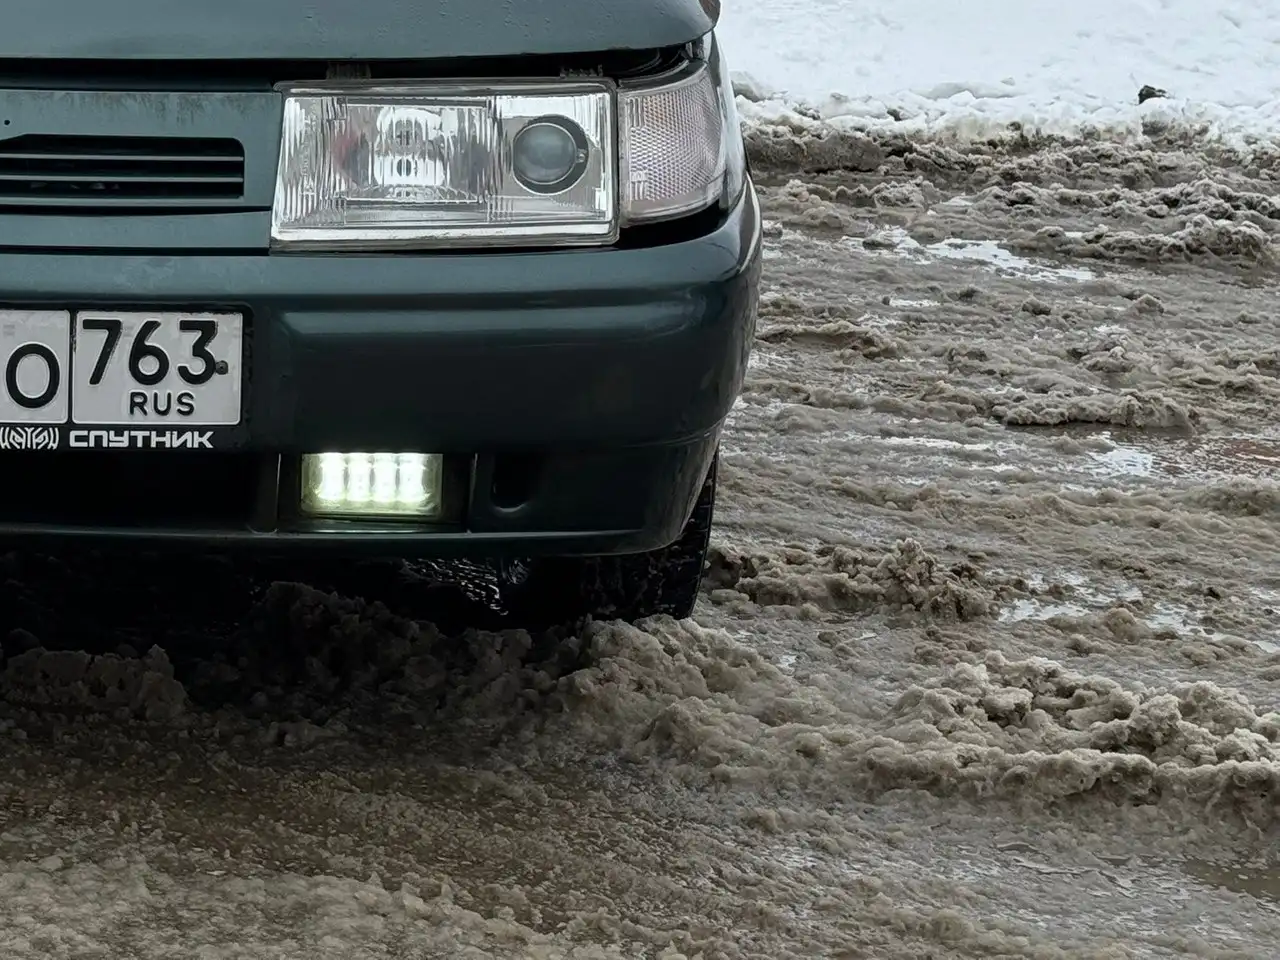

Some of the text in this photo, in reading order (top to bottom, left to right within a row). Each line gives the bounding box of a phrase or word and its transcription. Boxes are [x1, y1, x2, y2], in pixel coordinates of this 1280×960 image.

[82, 319, 217, 385] 763
[129, 391, 196, 415] RUS
[70, 431, 213, 449] СПУТНИК
